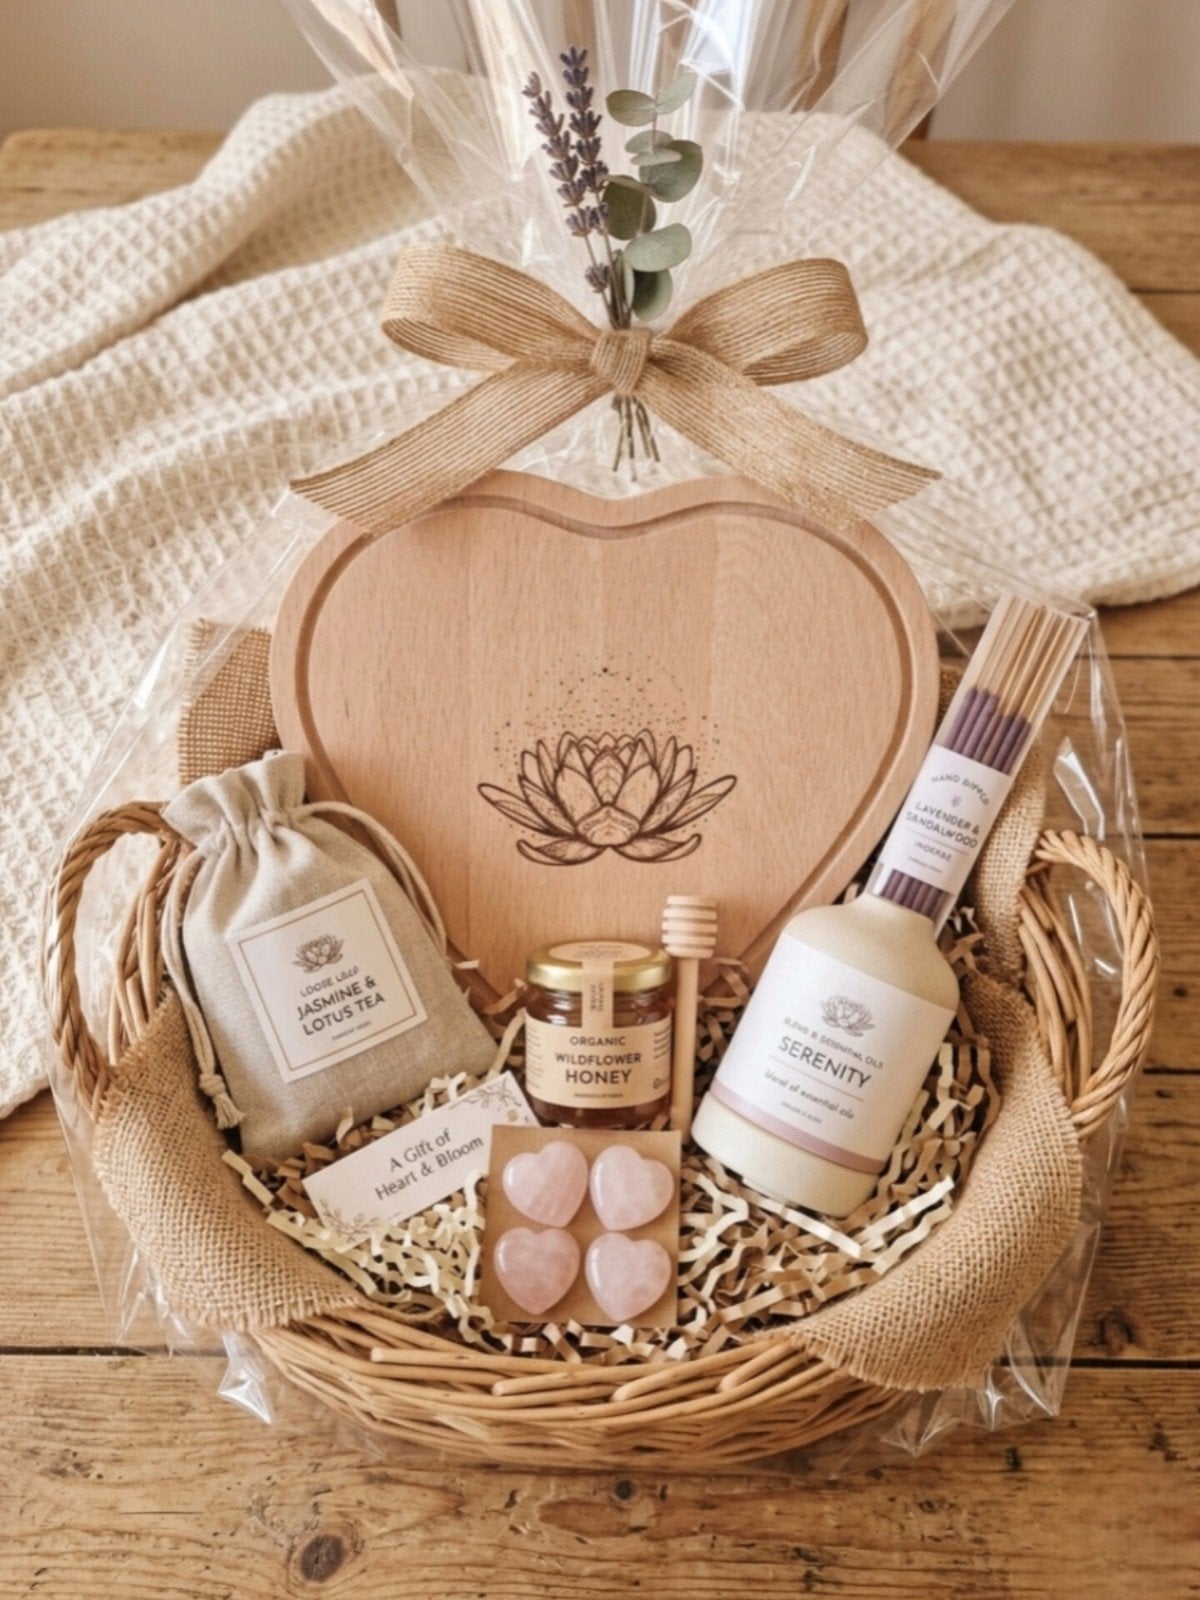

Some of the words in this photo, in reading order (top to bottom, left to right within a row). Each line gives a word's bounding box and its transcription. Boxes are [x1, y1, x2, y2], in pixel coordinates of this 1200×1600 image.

[906, 811, 978, 848] SANDALWOOD
[916, 802, 971, 830] LAVENDER
[297, 981, 362, 1020] JASMINE
[365, 975, 377, 989] &
[302, 1004, 353, 1036] LOTUS
[355, 992, 386, 1013] TEA
[555, 1052, 642, 1066] WILDFLOWER
[570, 1036, 626, 1046] ORGANIC
[565, 1069, 632, 1084] HONEY
[778, 1036, 872, 1089] SERENITY
[375, 1168, 418, 1200] Heart
[420, 1160, 435, 1176] &
[435, 1136, 484, 1168] Bloom
[389, 1157, 403, 1172] A
[404, 1139, 432, 1164] Gift
[435, 1127, 451, 1146] of
